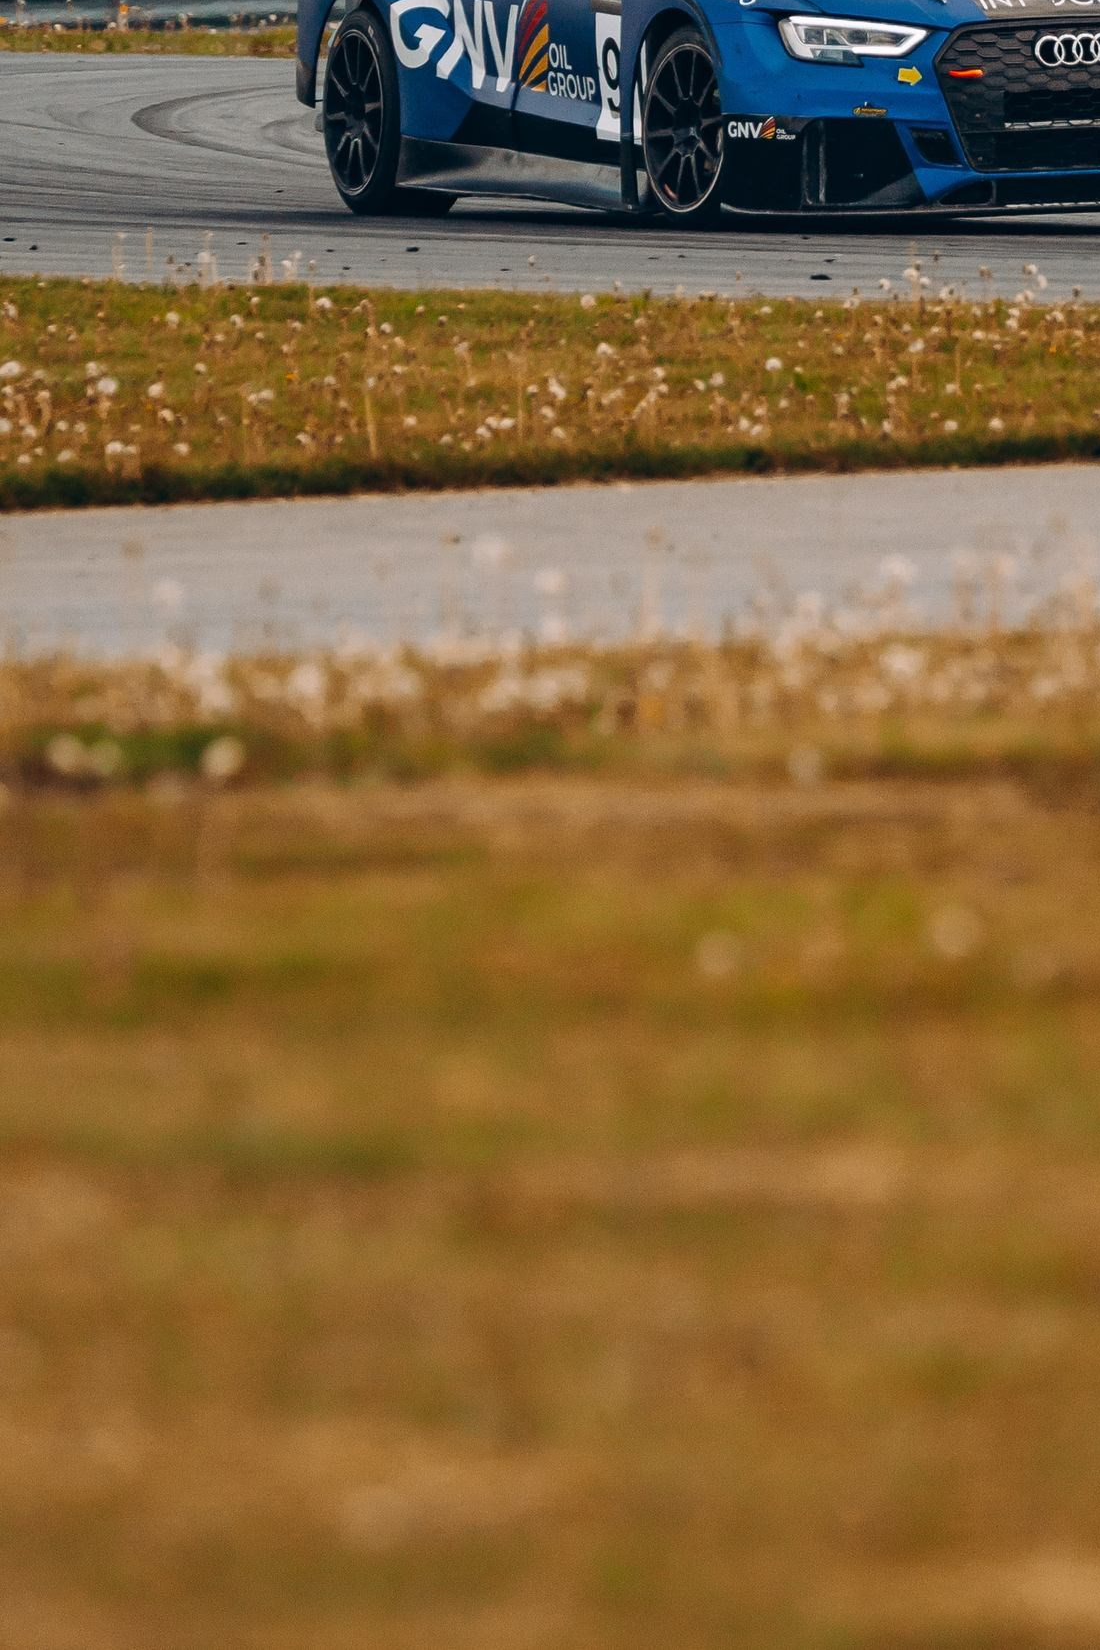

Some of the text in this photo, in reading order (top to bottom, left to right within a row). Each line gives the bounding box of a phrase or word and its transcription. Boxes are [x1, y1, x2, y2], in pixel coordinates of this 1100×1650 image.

[548, 42, 573, 71] OIL
[547, 71, 597, 101] GROUP
[727, 120, 763, 139] GNV
